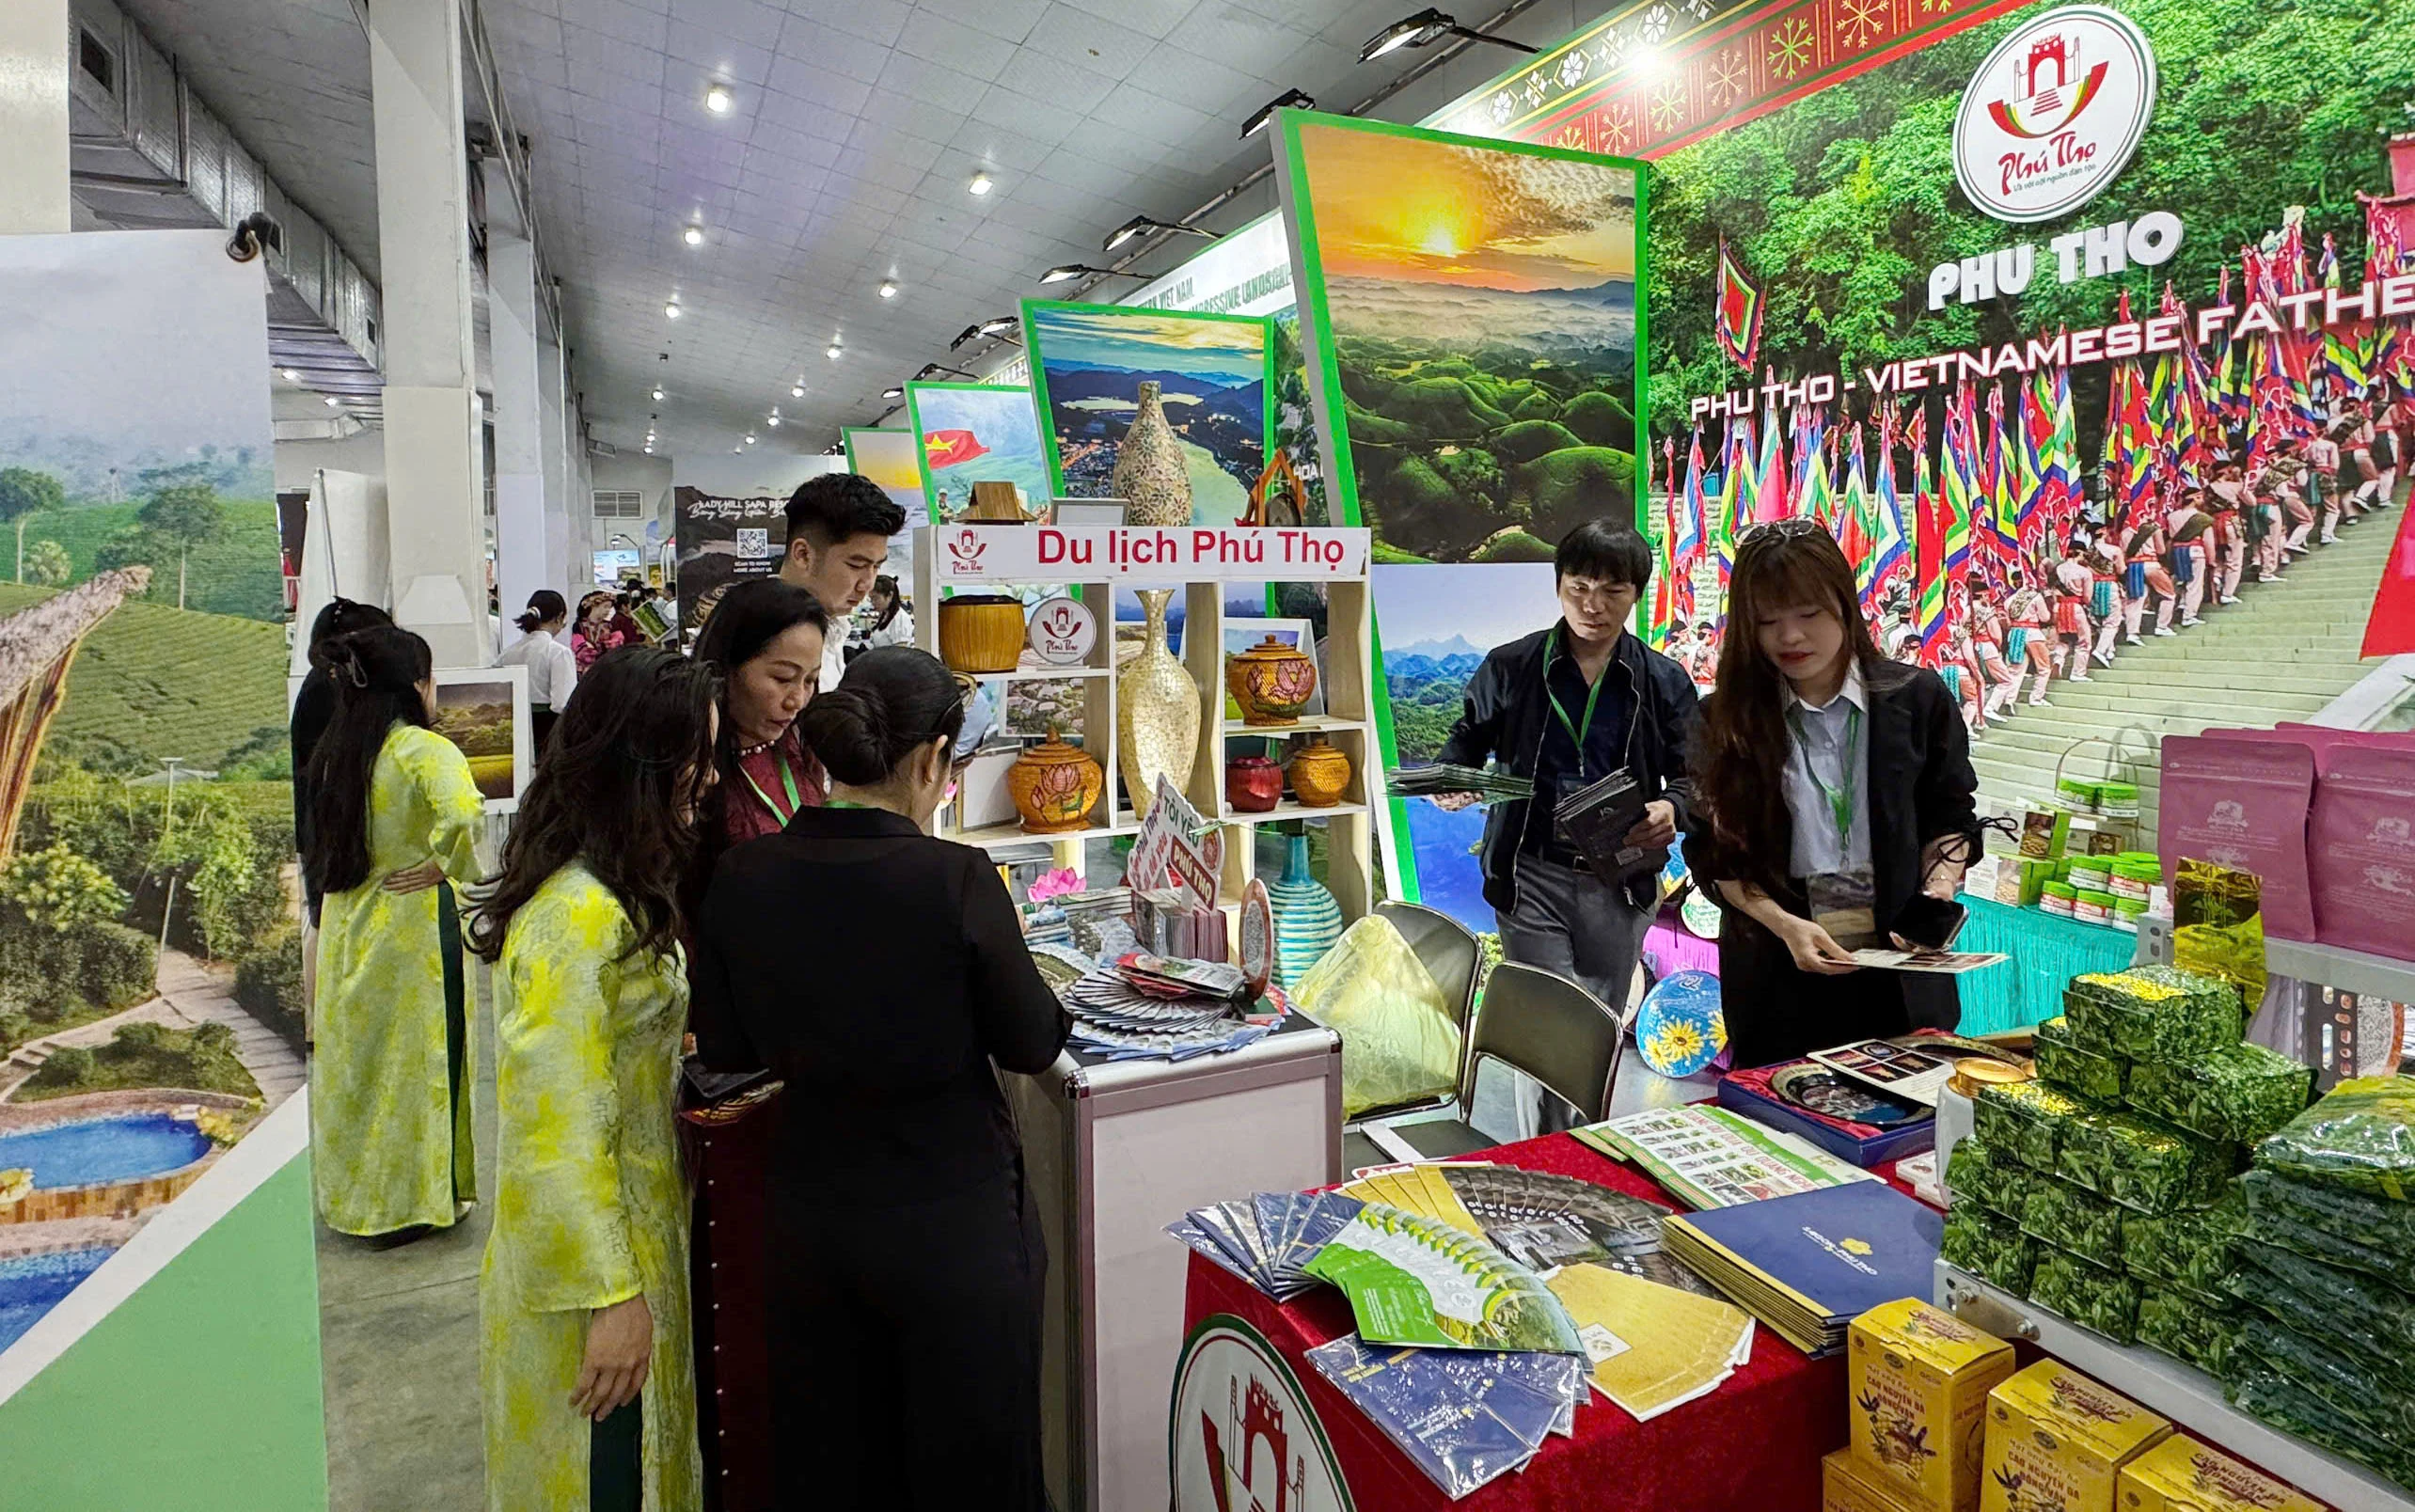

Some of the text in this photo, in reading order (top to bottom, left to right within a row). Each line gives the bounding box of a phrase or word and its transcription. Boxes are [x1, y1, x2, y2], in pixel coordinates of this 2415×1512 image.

[1998, 131, 2096, 196] Phú Thọ
[1929, 212, 2184, 311] PHU THO
[1692, 388, 1755, 421] PHU
[1760, 374, 1835, 409] THO
[1864, 315, 2184, 395] VIETNAMESE
[745, 500, 767, 509] SAPA
[1038, 530, 1344, 572] Du lịch Phú Thọ
[1163, 795, 1178, 827] TÔI
[1174, 846, 1212, 904] PHÚ THỌ
